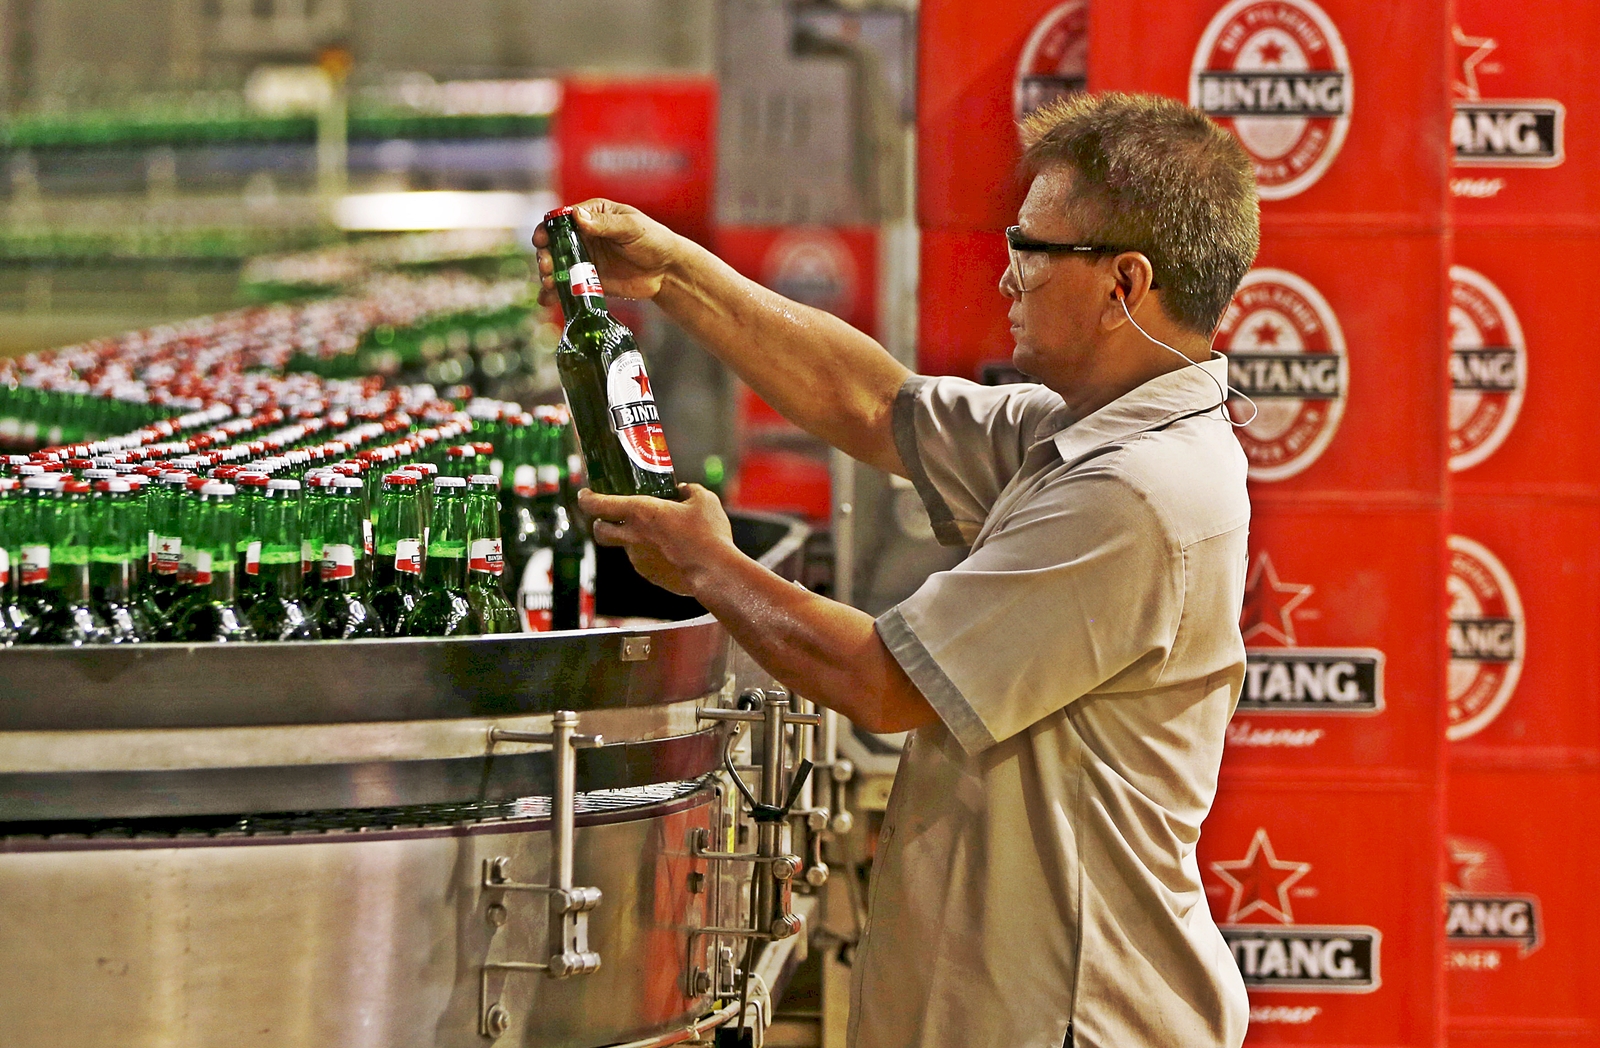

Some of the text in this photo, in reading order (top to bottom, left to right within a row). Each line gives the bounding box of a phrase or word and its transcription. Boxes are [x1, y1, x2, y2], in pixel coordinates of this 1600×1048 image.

[1202, 77, 1342, 113] BINTANG
[1451, 111, 1540, 153] ANG
[1246, 662, 1359, 701] TANG
[1446, 902, 1528, 936] ANG
